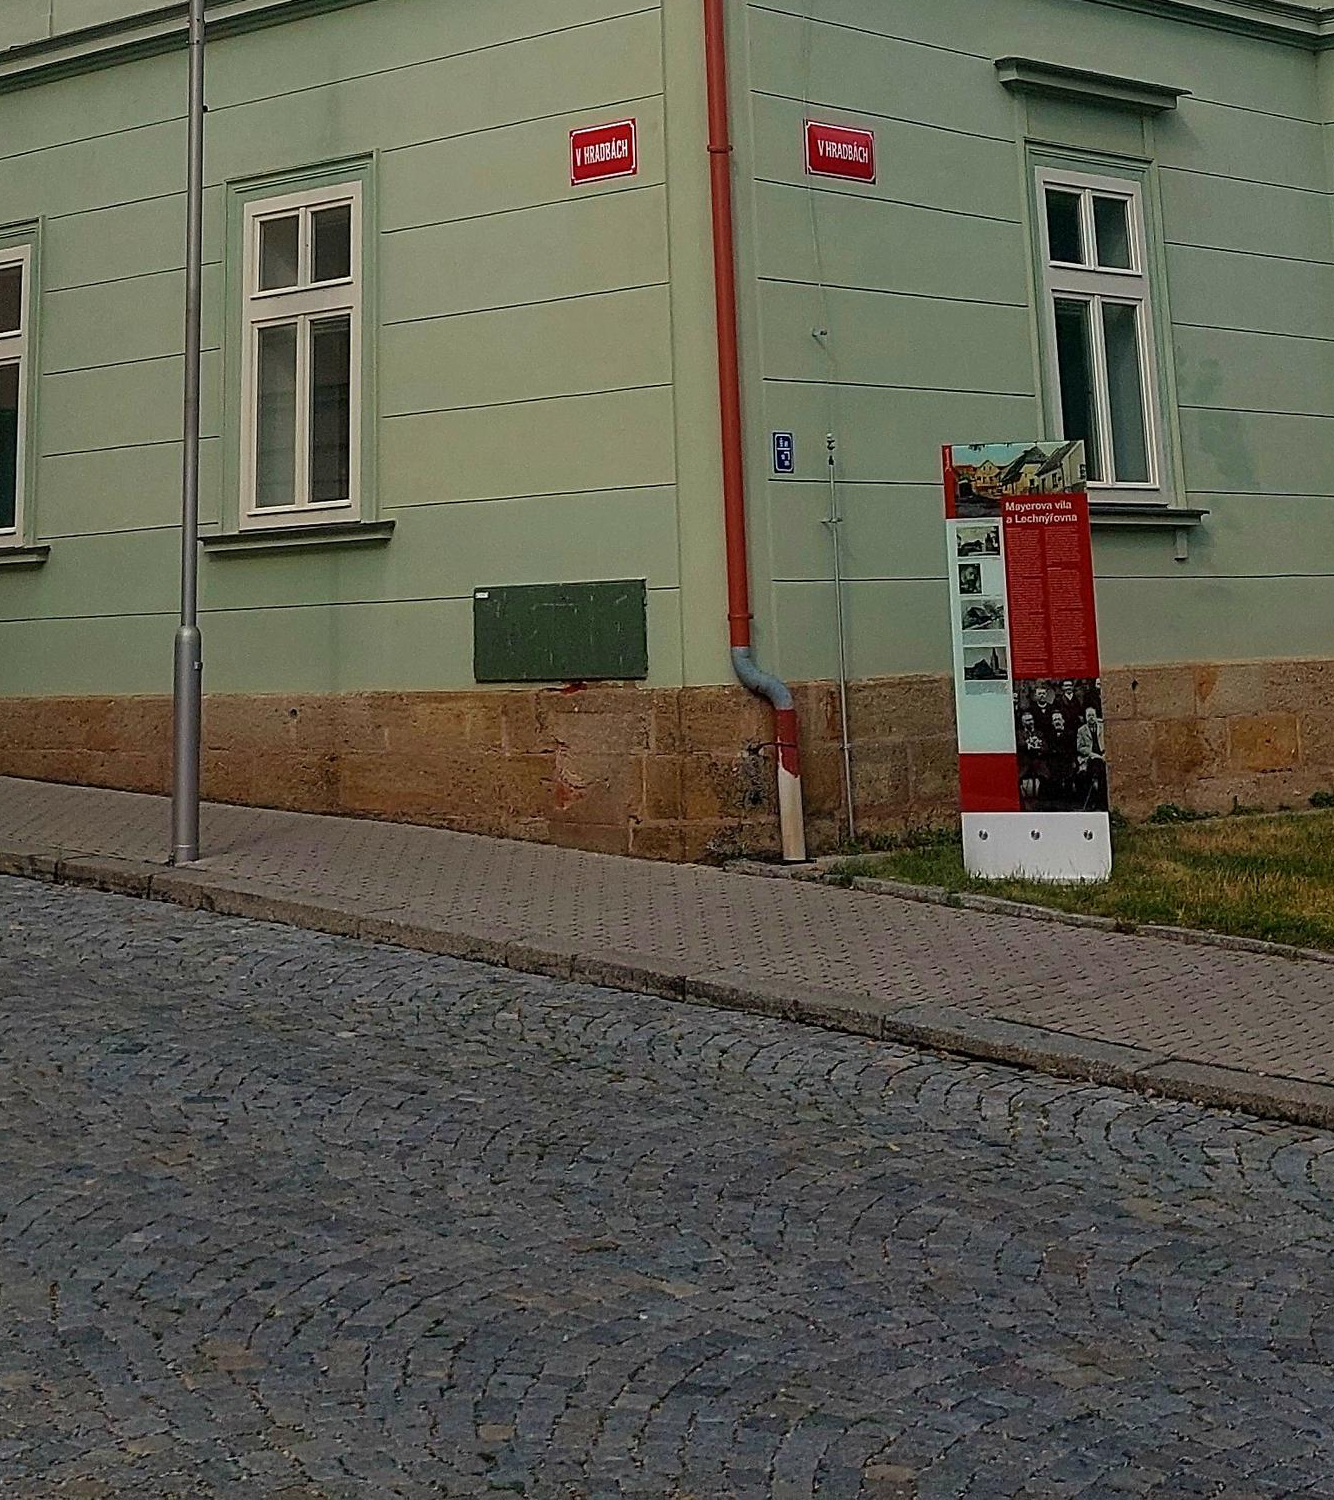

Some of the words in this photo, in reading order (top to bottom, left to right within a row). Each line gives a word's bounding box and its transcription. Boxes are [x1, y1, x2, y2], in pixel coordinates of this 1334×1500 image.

[575, 148, 581, 167] V
[584, 137, 628, 165] HRADBÁCH
[817, 139, 825, 157] V
[825, 141, 869, 164] HRADBÁCH
[1005, 501, 1053, 513] Mayerova
[1054, 500, 1072, 510] vila
[1015, 512, 1078, 525] Lechnýřovna
